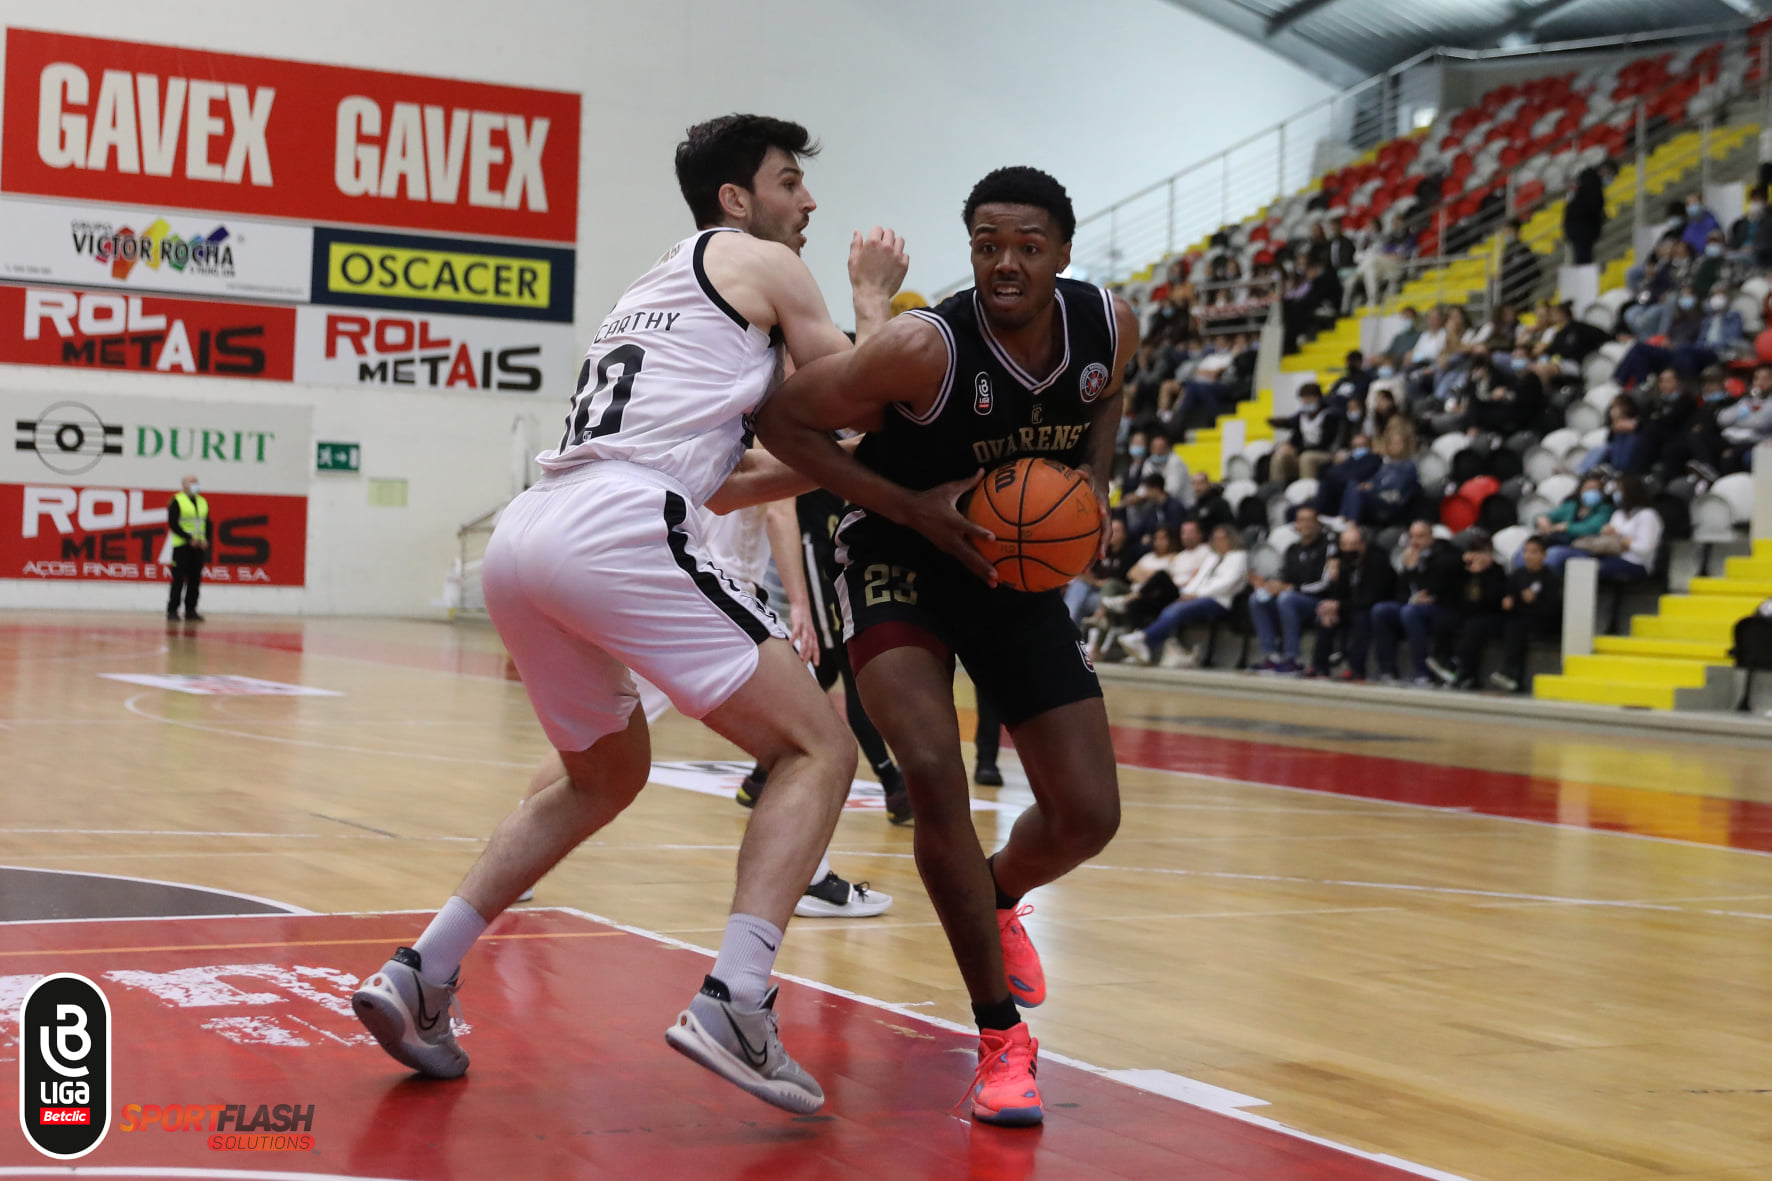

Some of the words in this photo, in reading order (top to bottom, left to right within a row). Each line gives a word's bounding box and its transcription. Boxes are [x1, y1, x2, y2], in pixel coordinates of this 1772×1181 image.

[37, 62, 275, 187] GAVEX
[335, 95, 550, 213] GAVEX
[73, 232, 152, 261] VICTOR
[160, 238, 234, 266] ROCHA
[341, 252, 538, 299] OSCACER
[24, 287, 167, 340] ROL
[325, 314, 452, 360] ROL
[61, 319, 266, 375] METAIS
[359, 343, 542, 391] METAIS
[136, 425, 275, 463] DURIT
[22, 486, 169, 539] ROL
[61, 515, 271, 565] METS
[83, 562, 139, 578] FINOS
[144, 564, 157, 579] E
[864, 563, 918, 608] 23
